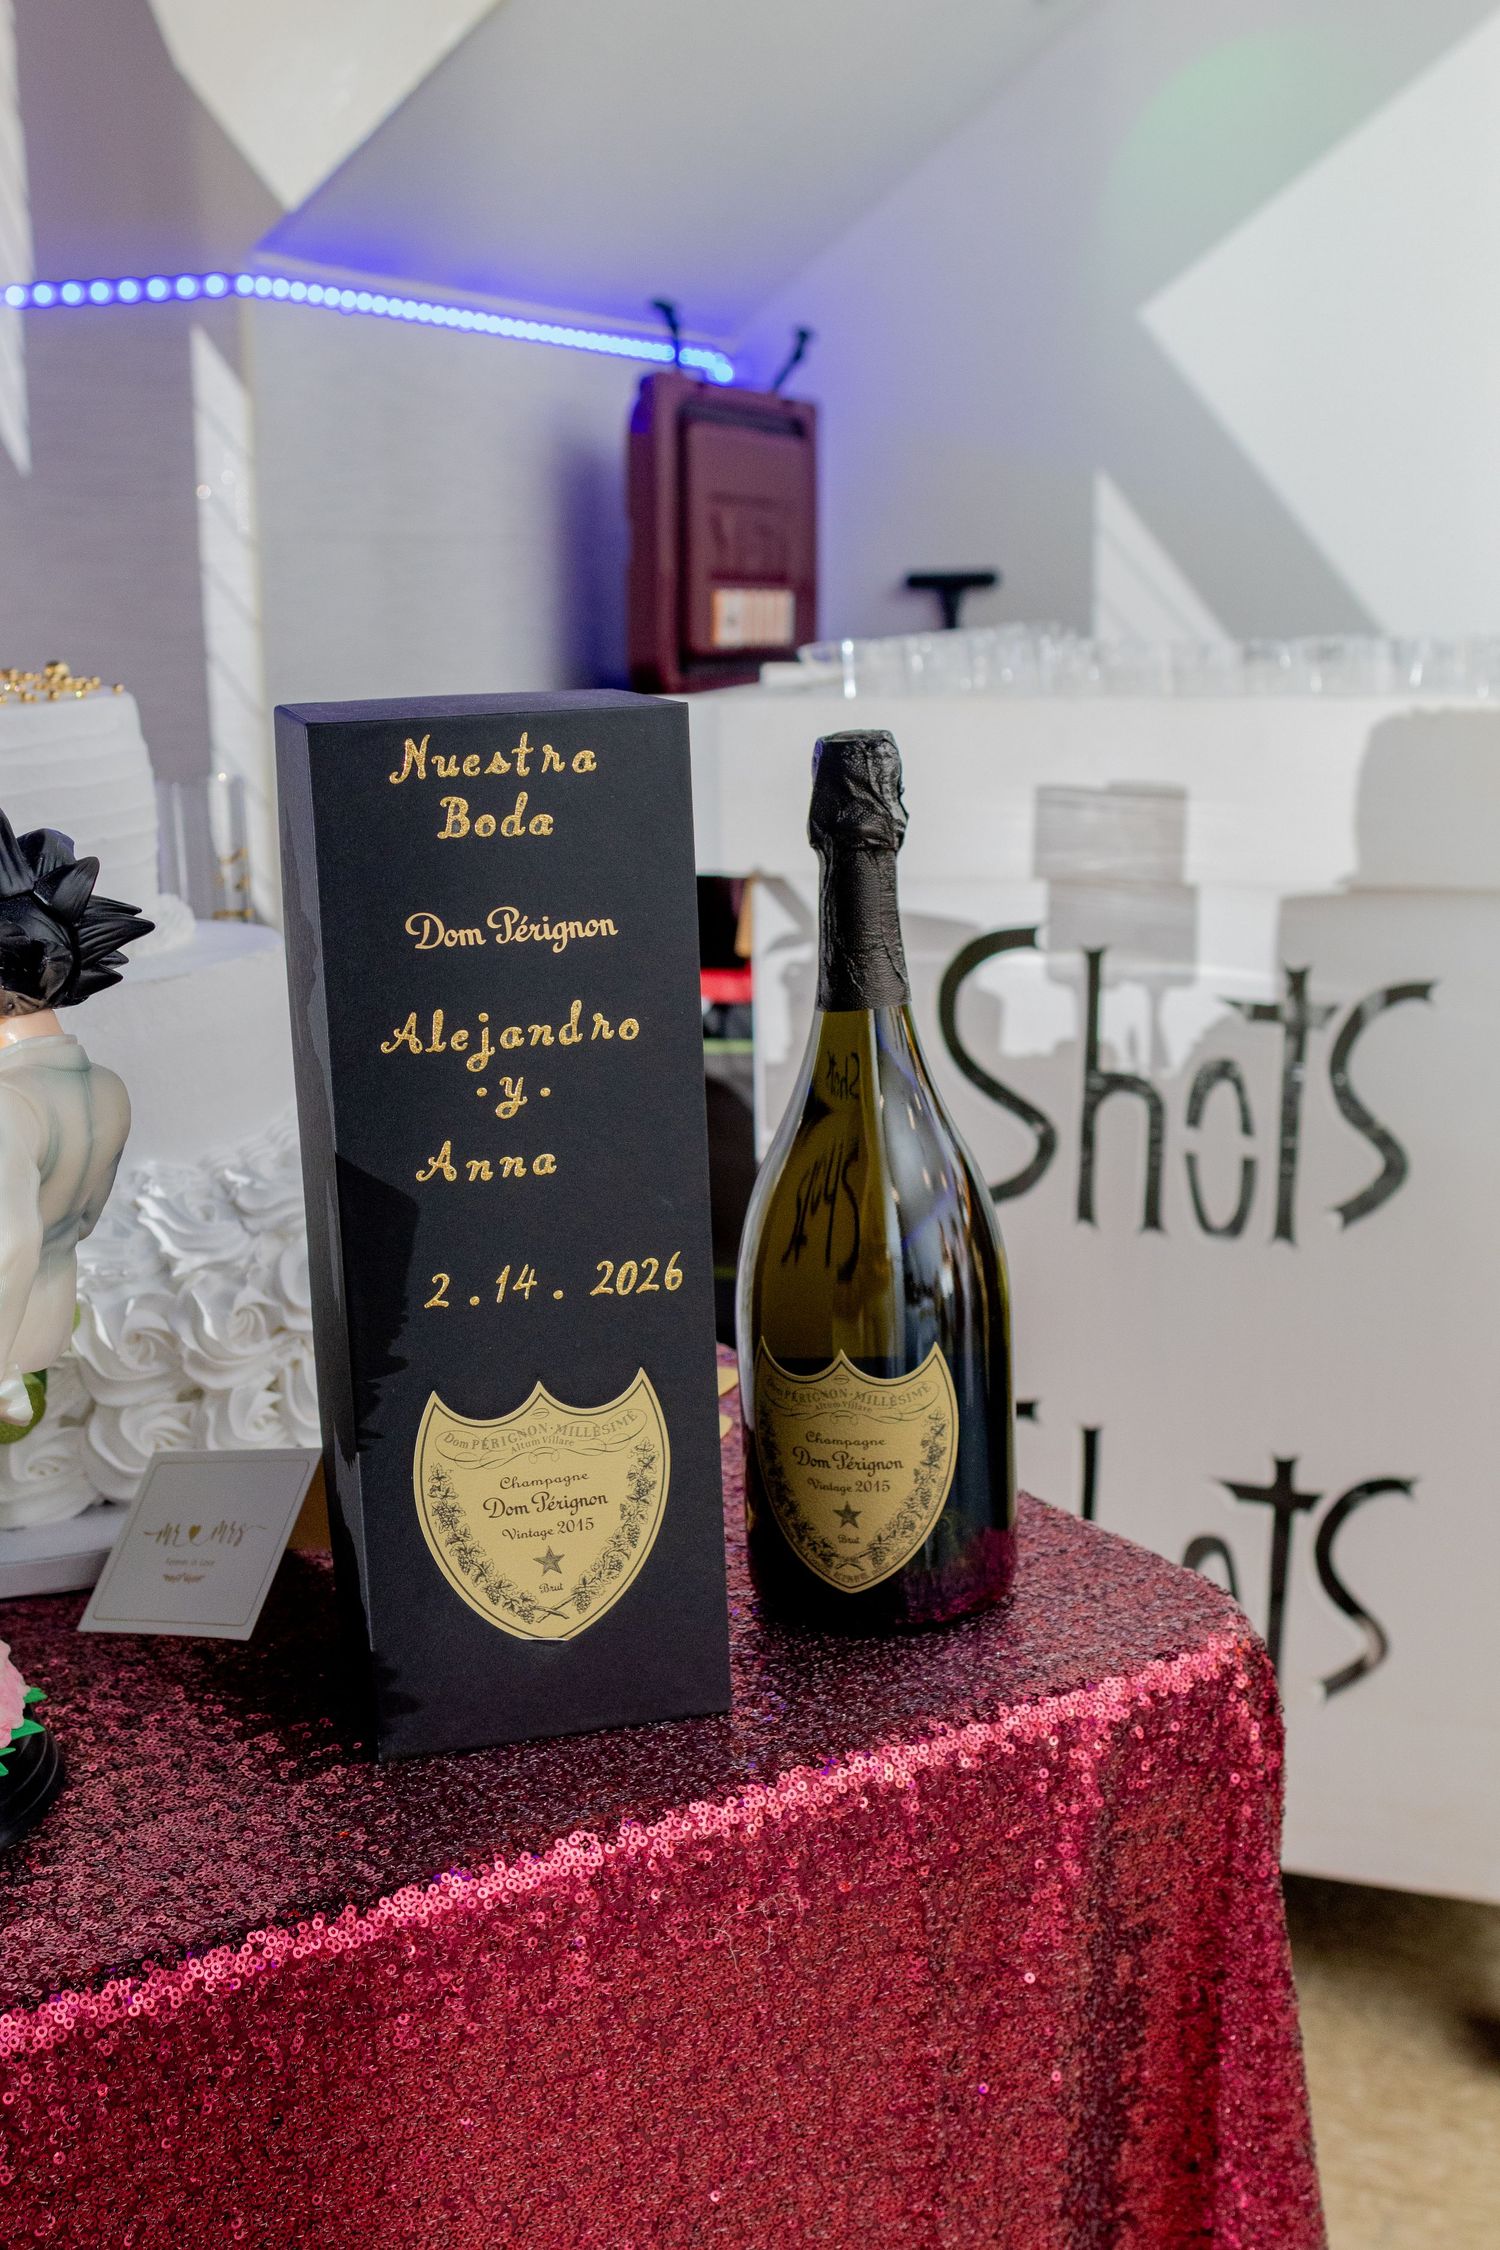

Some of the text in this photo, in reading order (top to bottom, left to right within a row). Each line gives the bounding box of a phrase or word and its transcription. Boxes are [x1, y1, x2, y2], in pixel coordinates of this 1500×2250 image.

[389, 732, 597, 785] Nuestra
[437, 791, 555, 839] Boda
[405, 906, 619, 953] Dom Pérignon
[380, 999, 640, 1072] Alejandro
[937, 926, 1438, 1247] Shots
[415, 1140, 558, 1182] Anna
[590, 1250, 684, 1297] 2026
[443, 1431, 470, 1450] Dom
[805, 1431, 887, 1450] Champagne
[792, 1446, 904, 1477] Dom Pérignon
[500, 1473, 590, 1490] Champagne
[807, 1477, 891, 1495] Vintage 2015
[483, 1491, 608, 1519] Dom Pérignon
[501, 1517, 595, 1541] Vintage 2015
[538, 1583, 564, 1594] Brut
